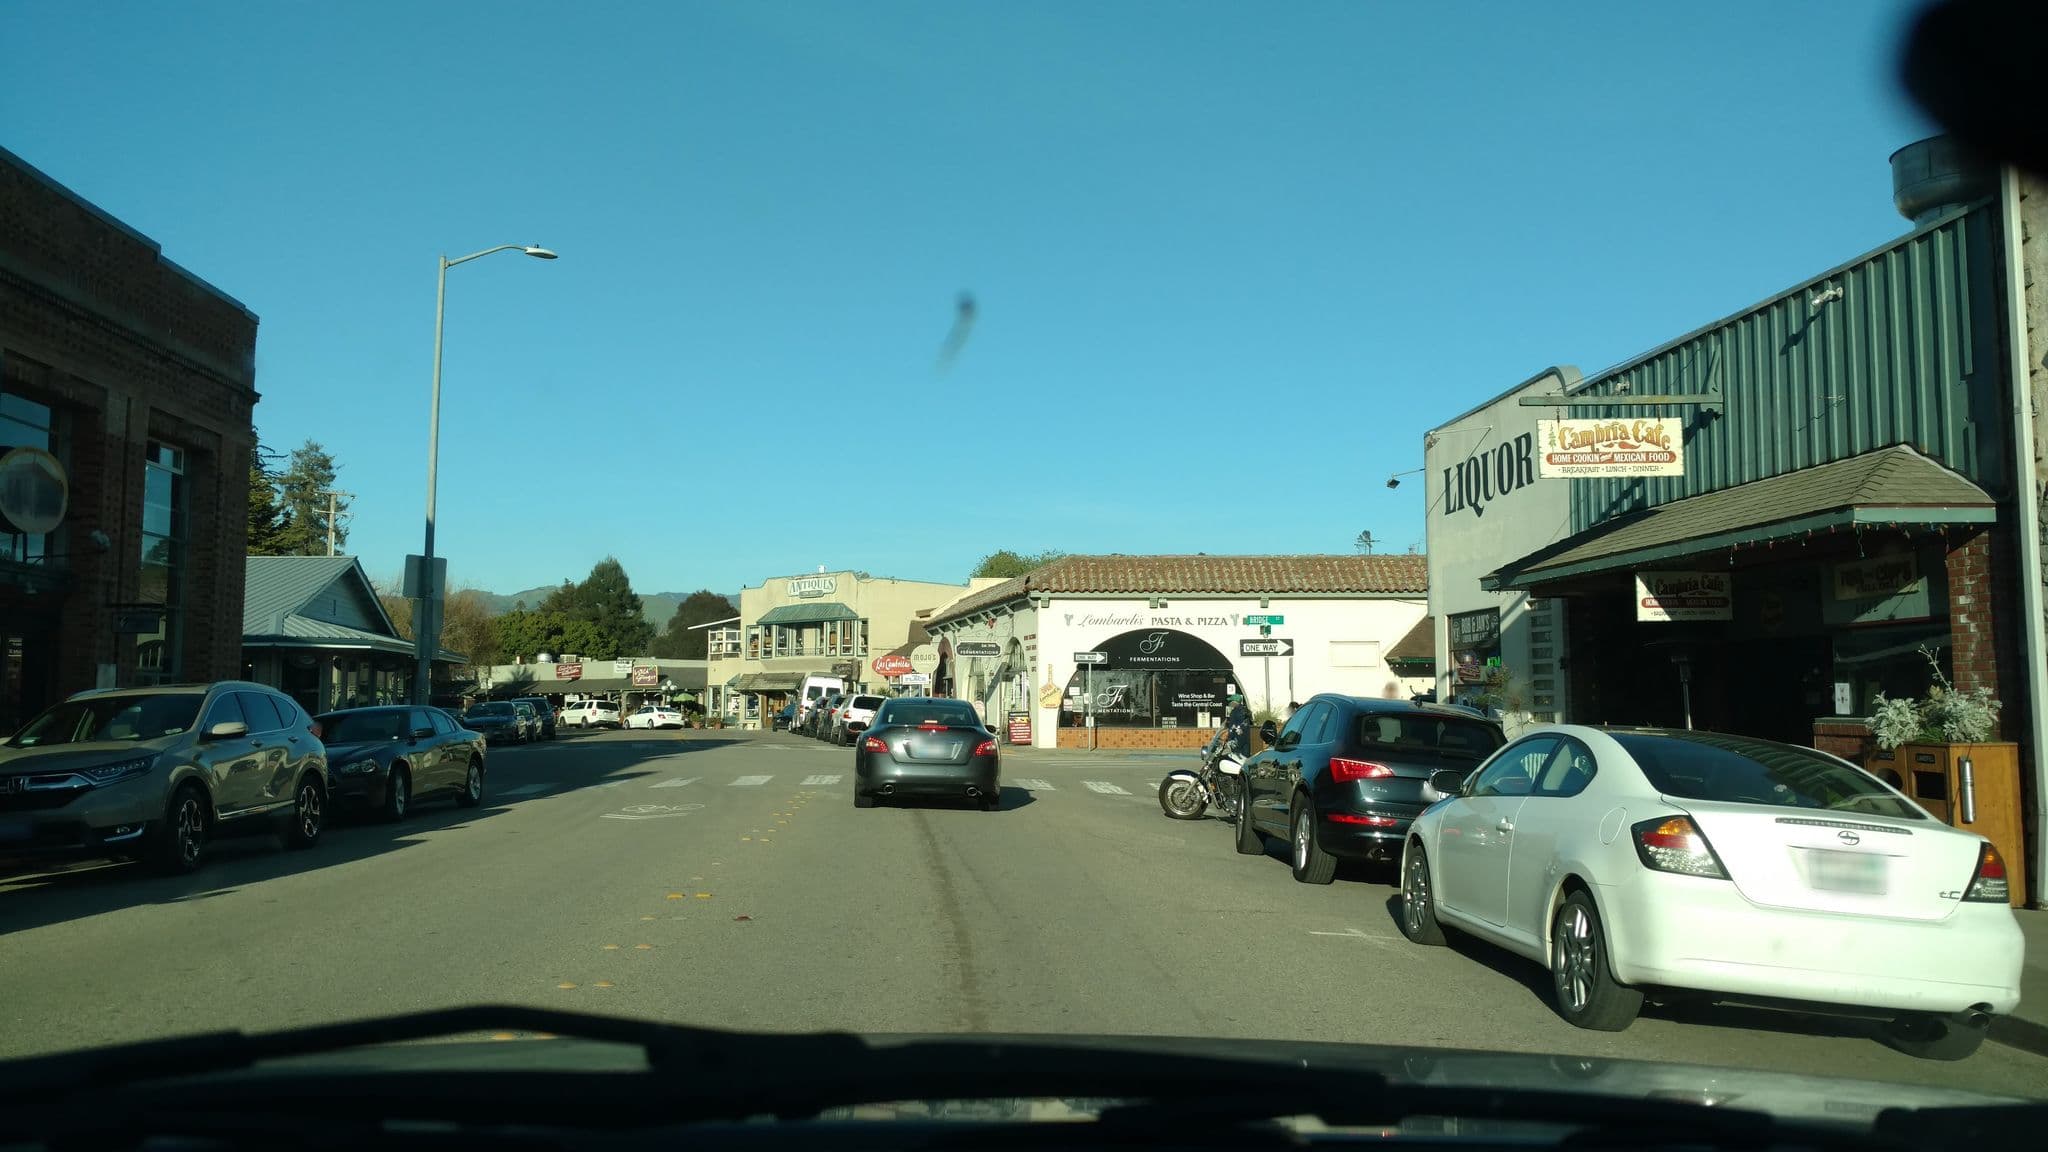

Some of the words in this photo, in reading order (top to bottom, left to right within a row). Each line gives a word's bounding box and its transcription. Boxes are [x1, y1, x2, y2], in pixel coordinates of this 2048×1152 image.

[1558, 421, 1631, 452] Cambria
[1632, 420, 1671, 450] Cafe
[1552, 453, 1571, 463] HOME
[1614, 452, 1646, 462] MEXICAN
[1648, 452, 1670, 462] FOOD
[1443, 431, 1535, 518] LIQUOR
[1562, 466, 1600, 474] BREAKFAST
[1606, 465, 1627, 473] LUNCH
[1632, 465, 1660, 473] DINNER
[790, 578, 834, 593] ANTIQUES
[1656, 577, 1699, 597] Cambria
[1151, 617, 1182, 626] PASTA
[1185, 617, 1194, 626] &
[1197, 617, 1229, 626] PIZZA
[1245, 644, 1261, 652] ONE
[1262, 644, 1278, 652] WAY
